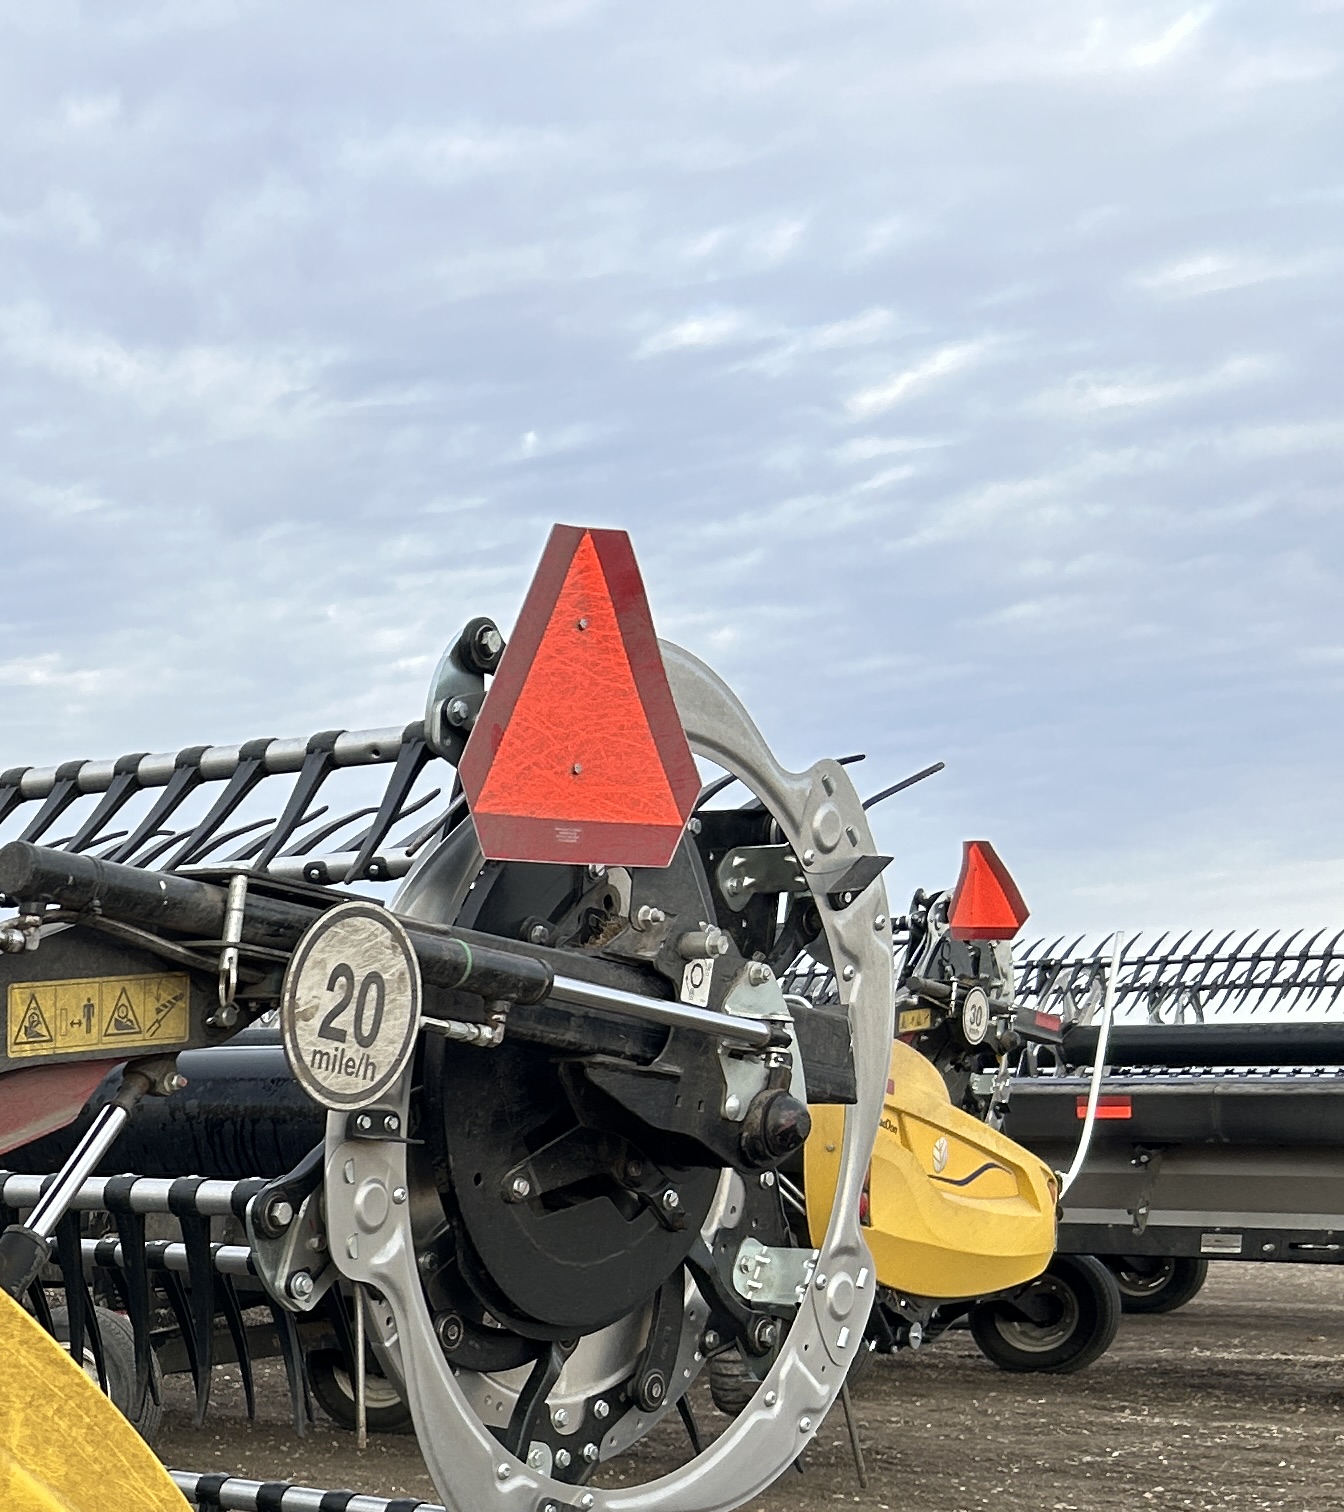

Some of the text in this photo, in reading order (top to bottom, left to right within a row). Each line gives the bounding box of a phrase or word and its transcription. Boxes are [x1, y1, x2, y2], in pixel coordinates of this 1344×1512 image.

[317, 962, 386, 1049] 20
[970, 1003, 983, 1027] 30
[310, 1046, 377, 1082] mile/h
